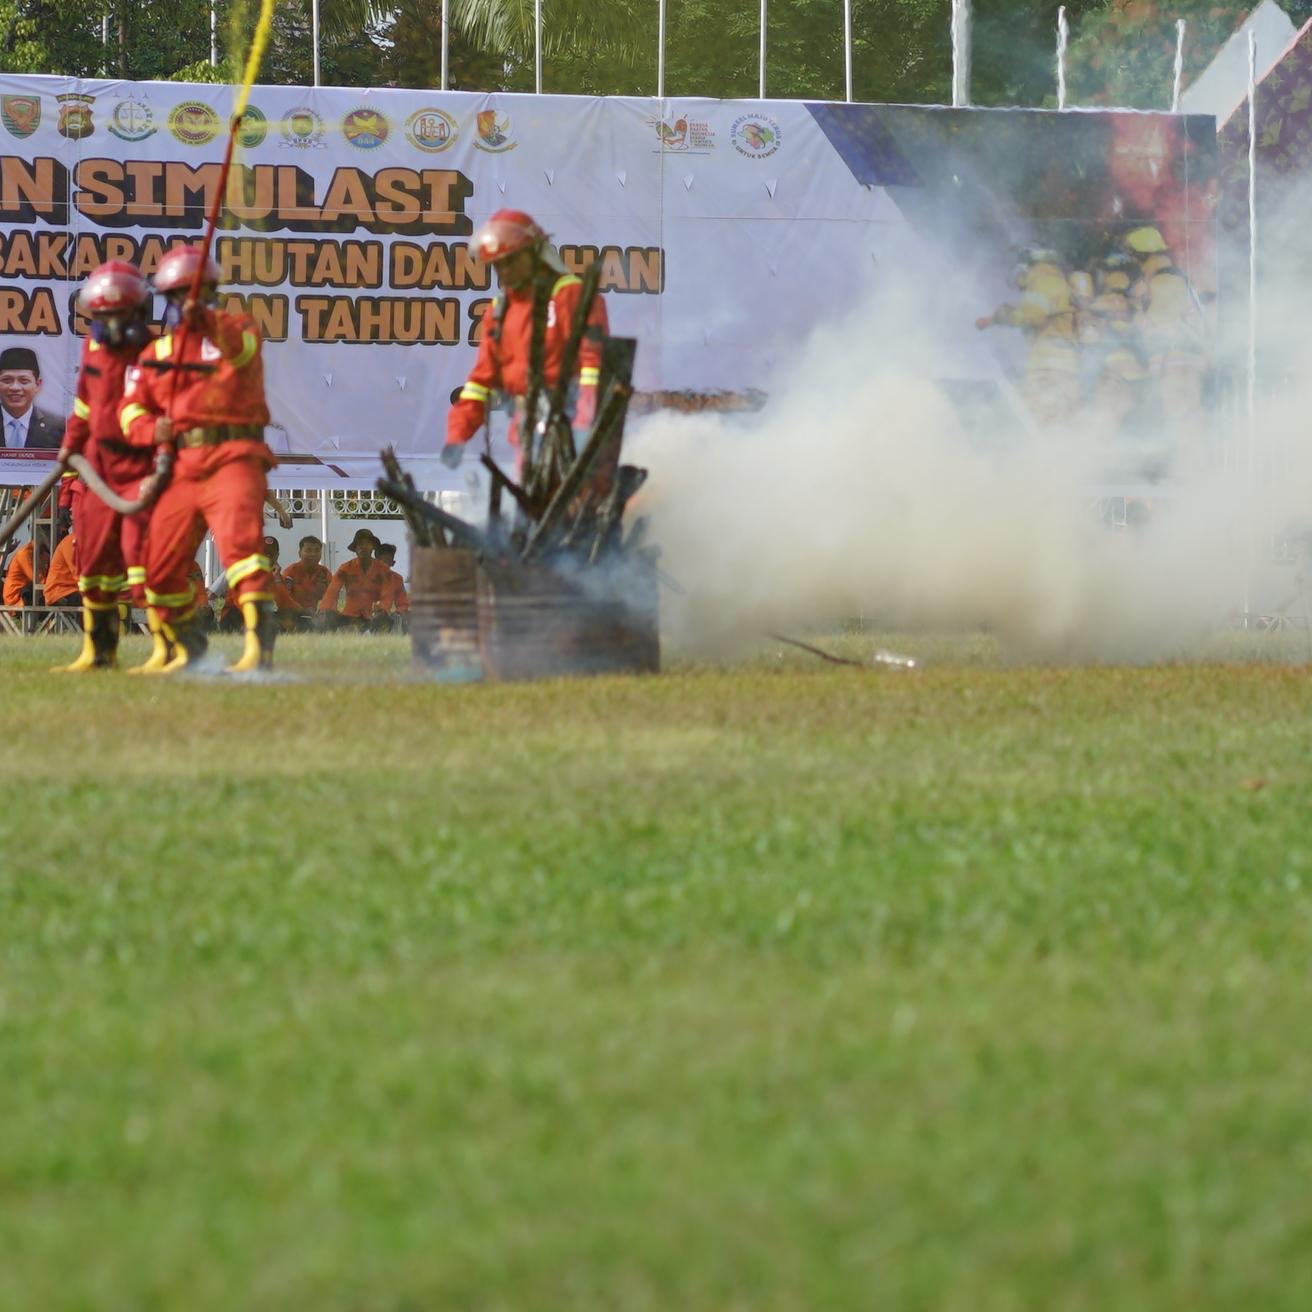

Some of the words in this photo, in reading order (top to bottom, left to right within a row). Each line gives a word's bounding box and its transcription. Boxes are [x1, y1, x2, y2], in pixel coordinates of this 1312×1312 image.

[73, 155, 473, 236] SIMULASI
[217, 238, 383, 288] HUTAN
[389, 241, 492, 290] DAN
[499, 243, 665, 294] HAN
[295, 295, 460, 346] TAHUN
